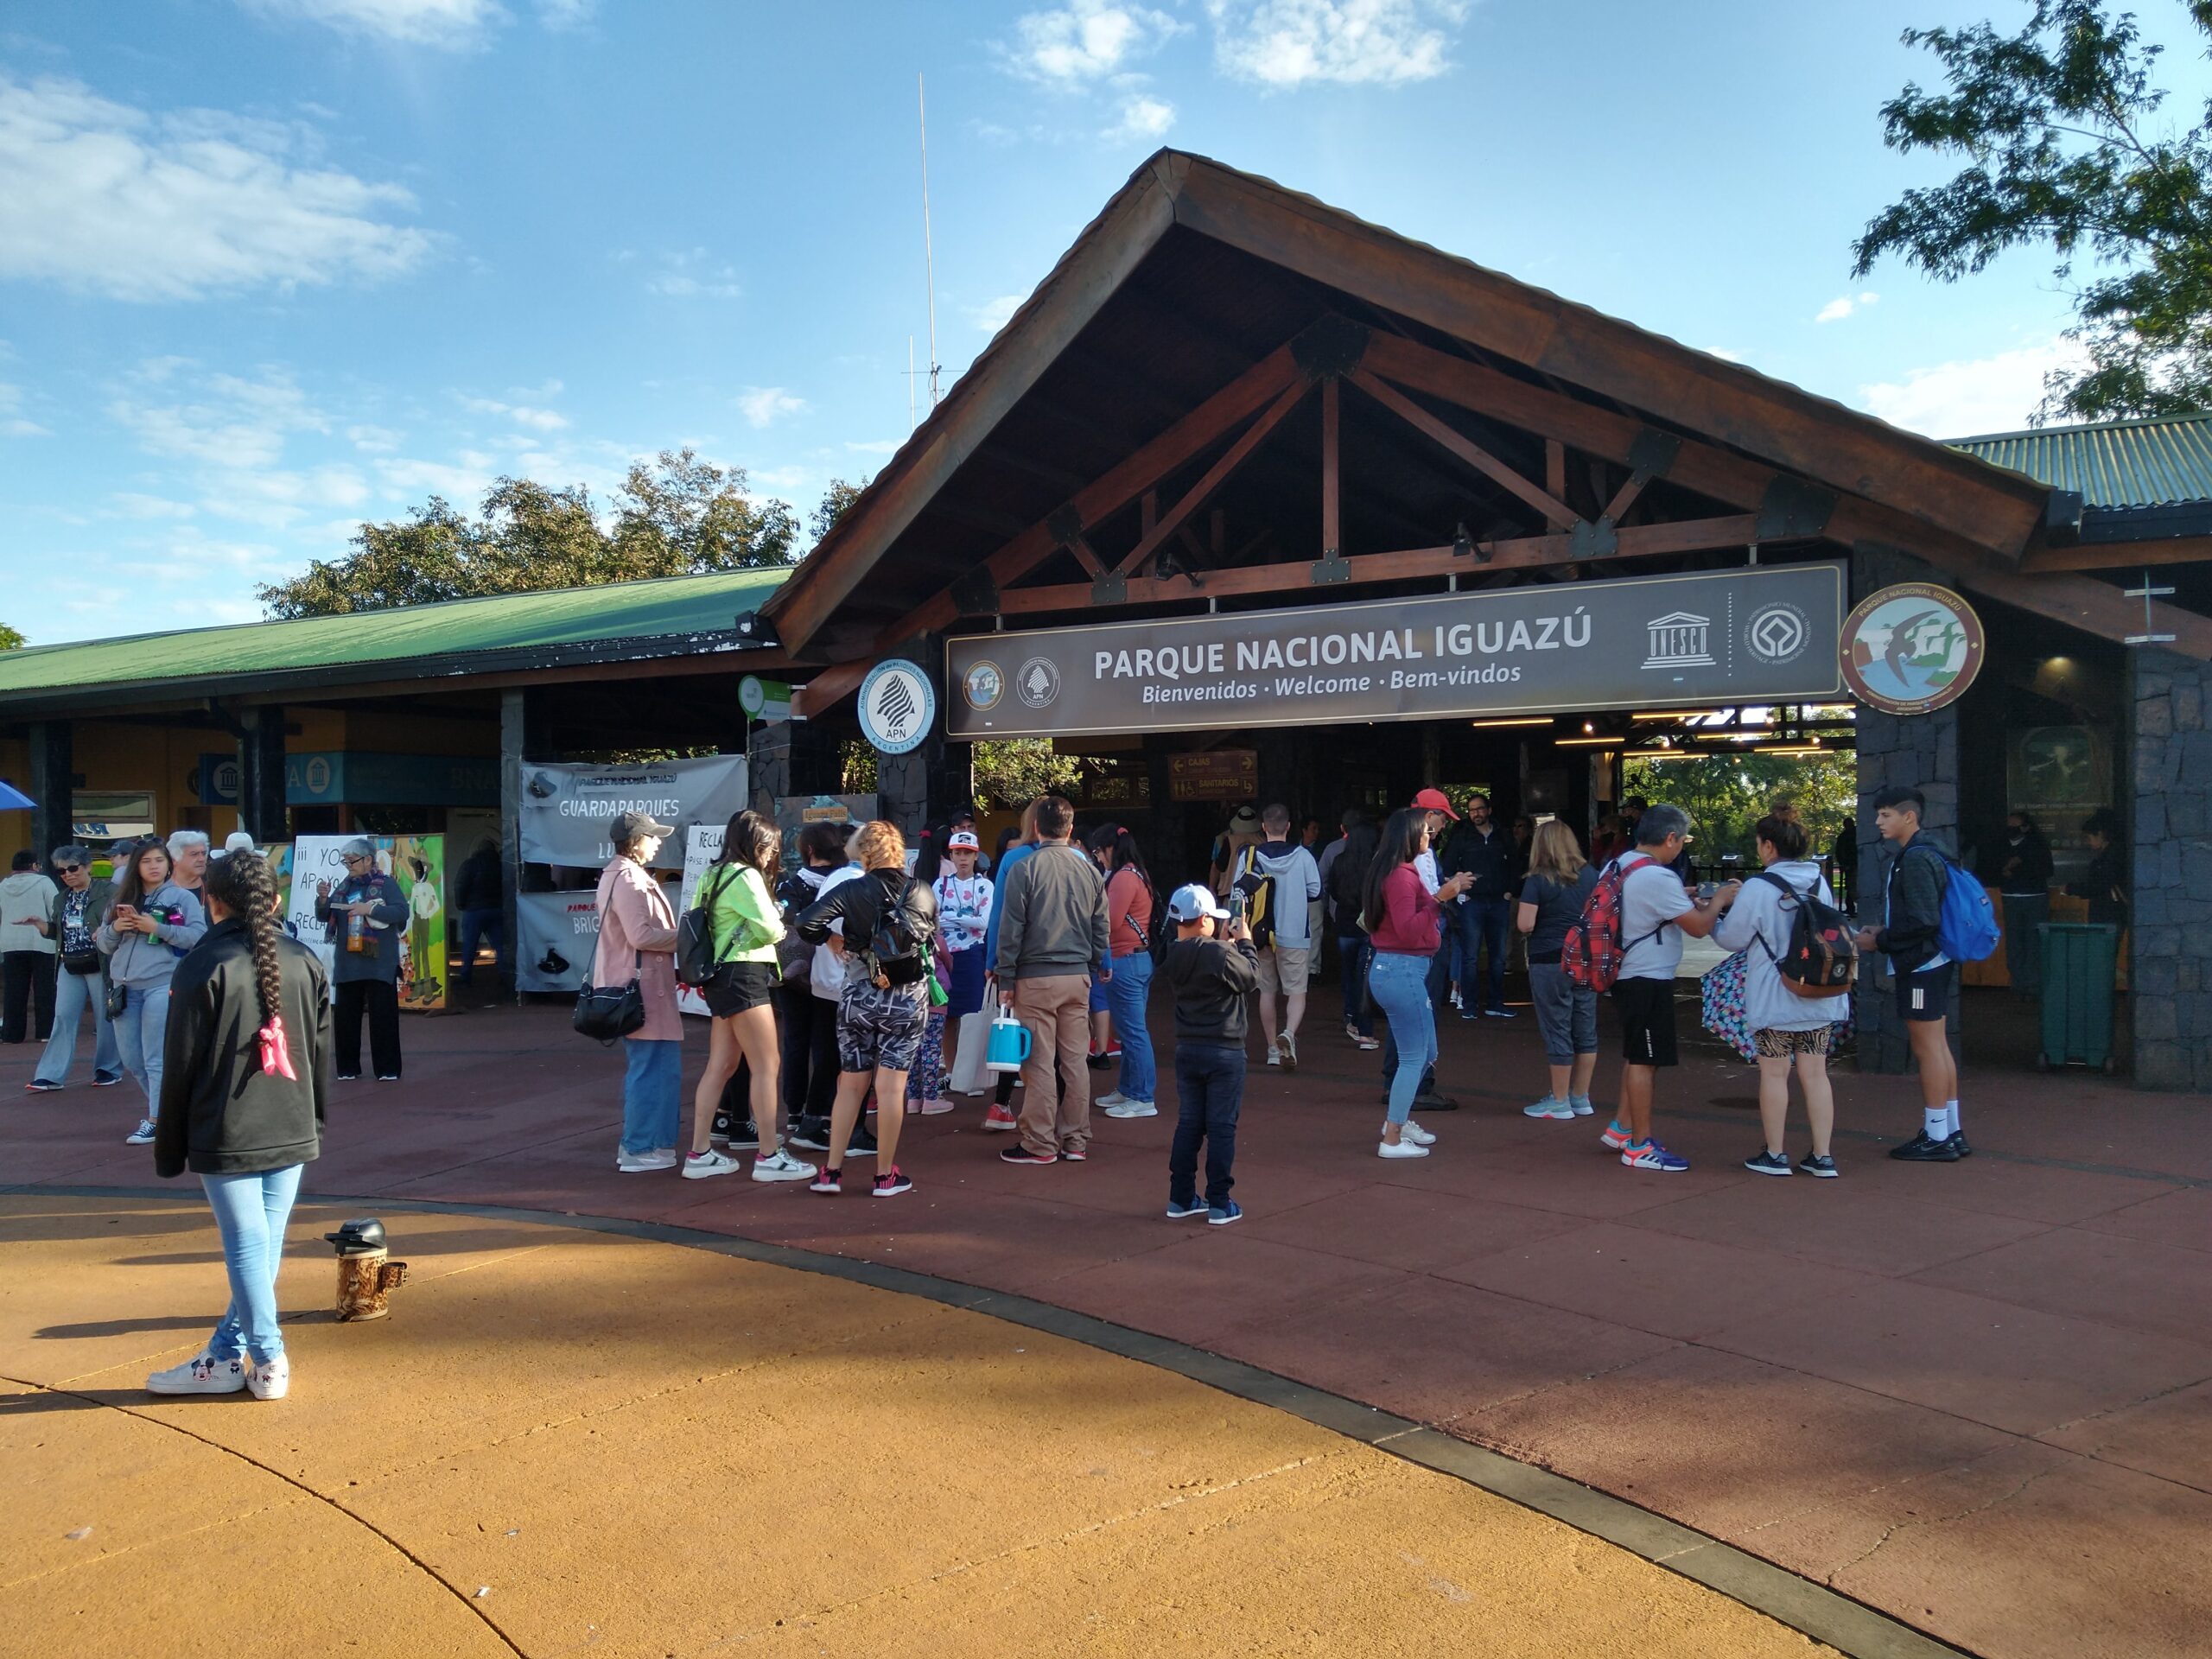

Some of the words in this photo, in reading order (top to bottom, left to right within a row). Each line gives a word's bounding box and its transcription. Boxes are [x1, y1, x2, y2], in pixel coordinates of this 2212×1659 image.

[1858, 592, 1889, 617] PARQUE
[1889, 588, 1931, 598] NACIONAL
[1095, 643, 1224, 680] PARQUE
[1237, 628, 1423, 671] NACIONAL
[1435, 606, 1592, 658] IGUAZÚ
[1650, 626, 1707, 657] UNESCO
[893, 662, 916, 673] PARQUES
[915, 671, 932, 708] NACIONALES
[1142, 680, 1257, 703] Bienvenidos
[1274, 675, 1370, 696] Welcome
[1389, 663, 1522, 690] Bem-vindos
[886, 728, 906, 739] APN
[871, 736, 920, 752] ARGENTINA
[1188, 757, 1211, 767] CAJAS
[1198, 779, 1239, 788] SANITARIOS
[559, 799, 680, 817] GUARDAPARQUES
[321, 848, 341, 867] YO
